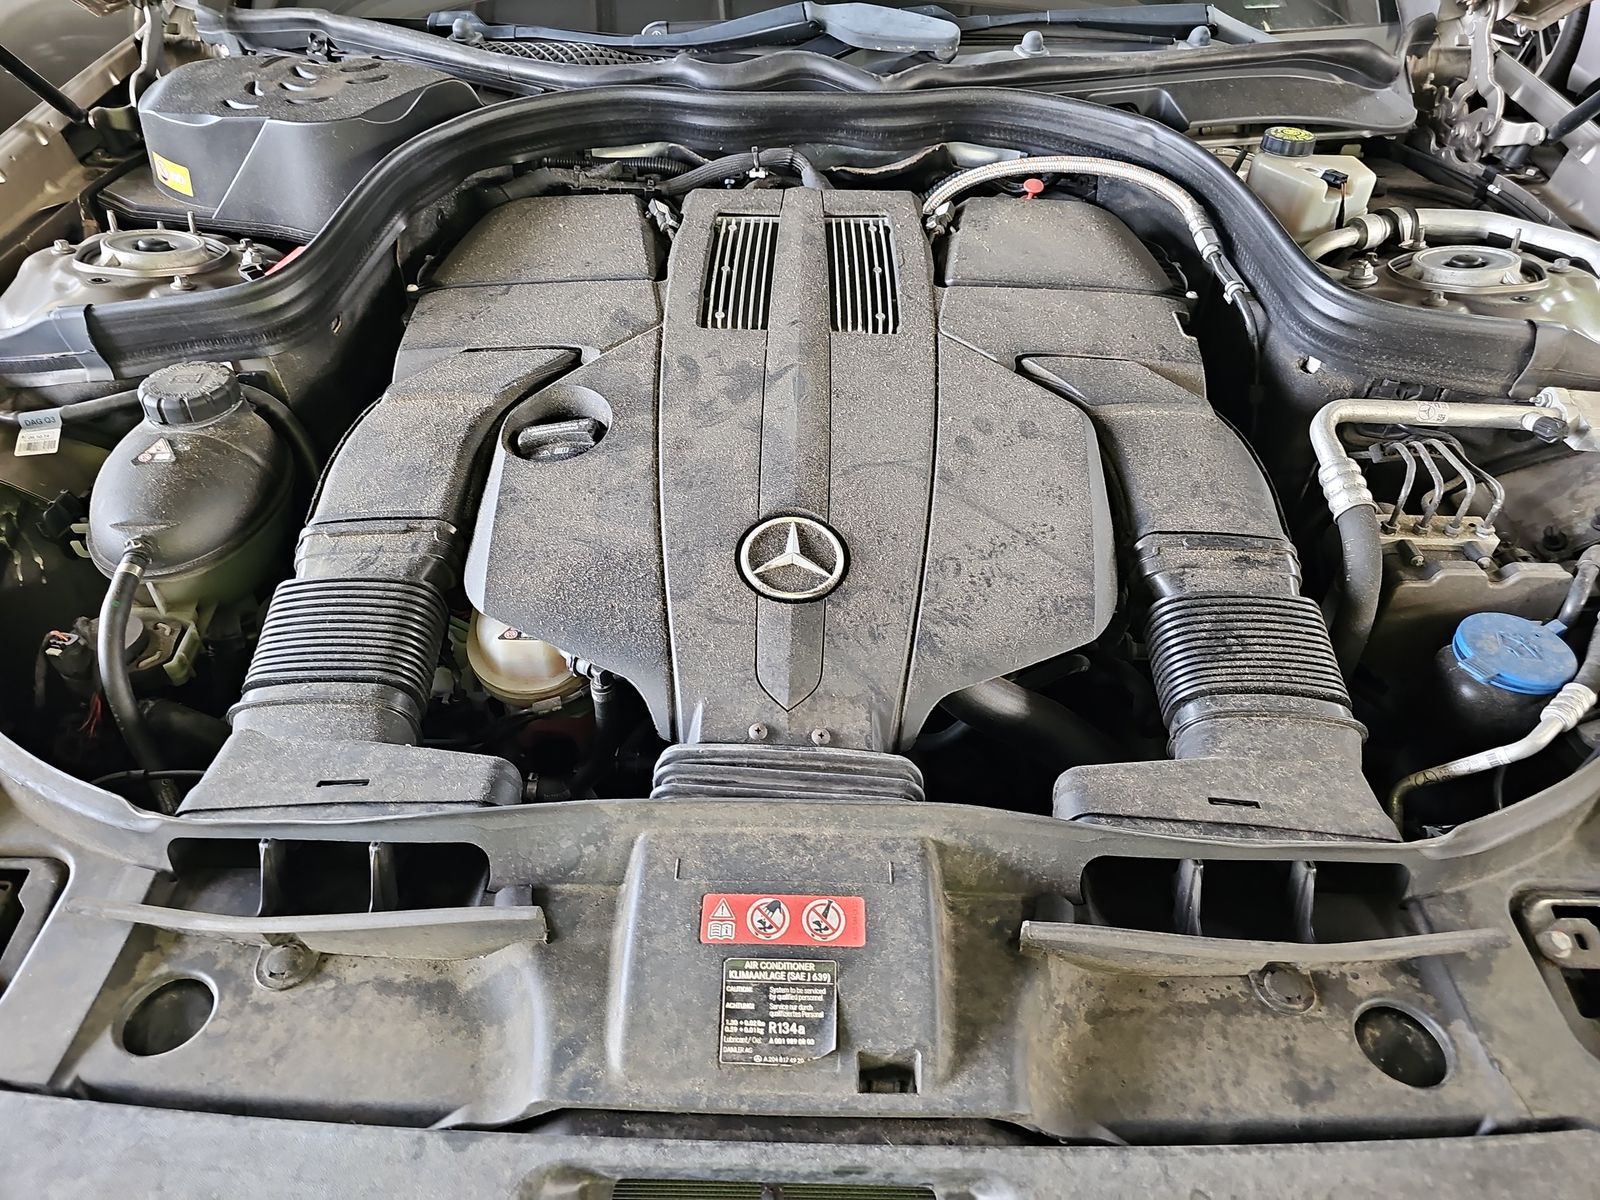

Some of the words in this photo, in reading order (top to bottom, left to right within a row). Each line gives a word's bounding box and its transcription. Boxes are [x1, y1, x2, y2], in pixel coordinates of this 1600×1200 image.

[24, 418, 43, 427] DAG
[744, 961, 759, 970] AIR
[760, 961, 815, 971] CONDITIONER
[728, 970, 786, 980] KLIMAANLAGE
[787, 972, 806, 982] (SAE
[811, 973, 832, 983] 639)
[768, 1021, 806, 1035] R134a
